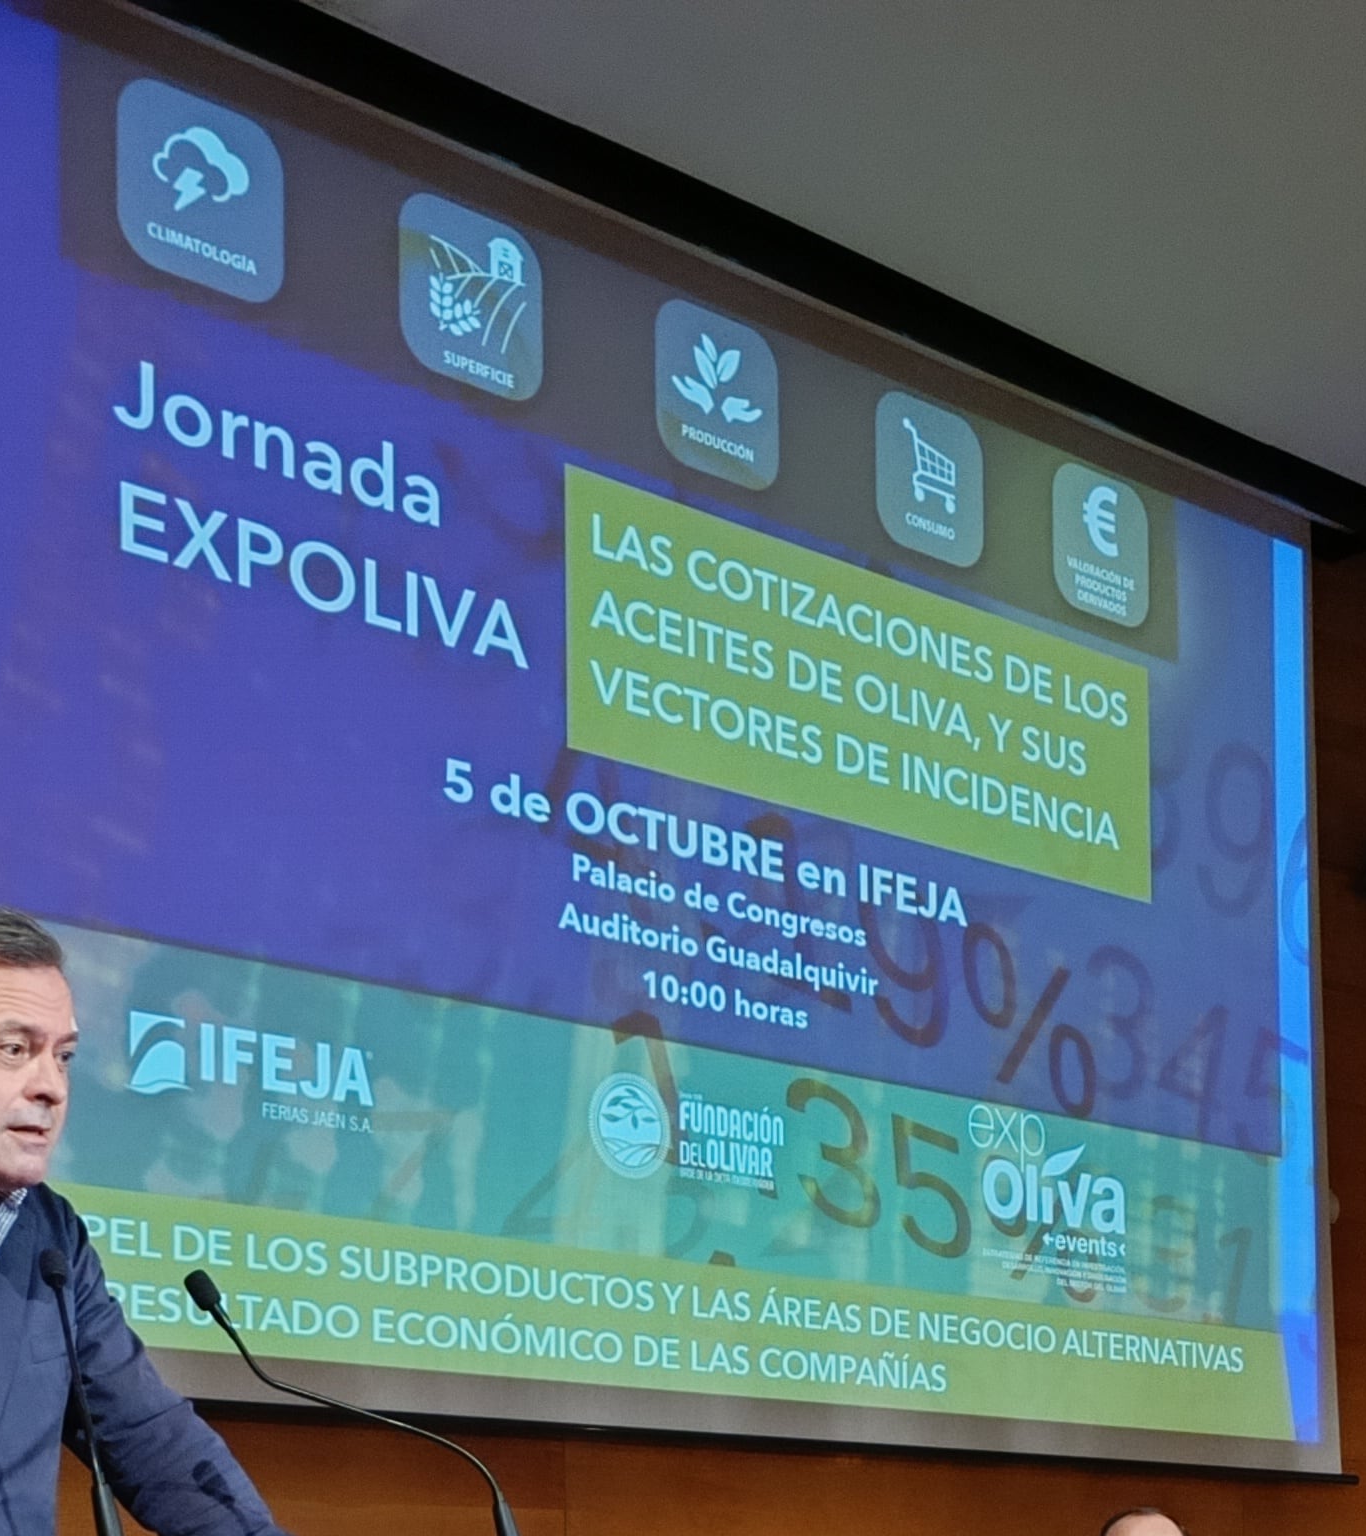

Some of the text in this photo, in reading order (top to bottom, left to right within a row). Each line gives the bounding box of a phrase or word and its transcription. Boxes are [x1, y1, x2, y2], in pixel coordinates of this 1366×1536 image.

[443, 350, 514, 389] SUPERFICIE
[112, 360, 440, 527] Jornada
[681, 423, 754, 463] PRODUCCIÓN
[905, 511, 955, 541] CONSUMO
[119, 480, 529, 669] EXPOLIVA
[591, 513, 1129, 728] LAS COTIZACIONES DE LOS
[589, 590, 1088, 778] ACEITES DE OLIVA, Y SUS
[589, 659, 1121, 851] VECTORES DE INCIDENCIA
[442, 757, 968, 928] 5 de OCTUBRE en IFEJA
[571, 852, 867, 948] Palacio de Congresos
[558, 901, 879, 997] Auditorio Guadalquivir
[641, 970, 809, 1030] 10:00 horas
[200, 1022, 374, 1107] IFEJA
[262, 1101, 309, 1124] FERIAS
[679, 1100, 784, 1147] FUNDACIÓN
[968, 1103, 1046, 1172] exp
[679, 1138, 774, 1178] DEL OLIVAR
[1054, 1233, 1117, 1258] events
[173, 1223, 233, 1267] DE
[246, 1232, 328, 1278] LOS
[339, 1244, 653, 1314] SUBPRODUCTOS
[660, 1280, 684, 1314] Y
[692, 1289, 751, 1323] LAS
[759, 1286, 862, 1335] ÁREAS
[870, 1307, 911, 1340] DE
[918, 1311, 1057, 1355] NEGOCIO
[1062, 1327, 1245, 1374] ALTERNATIVAS
[372, 1313, 623, 1366] ECONÓMICO
[634, 1335, 680, 1373] DE
[690, 1340, 750, 1376] LAS
[758, 1347, 948, 1394] COMPAÑÍAS
